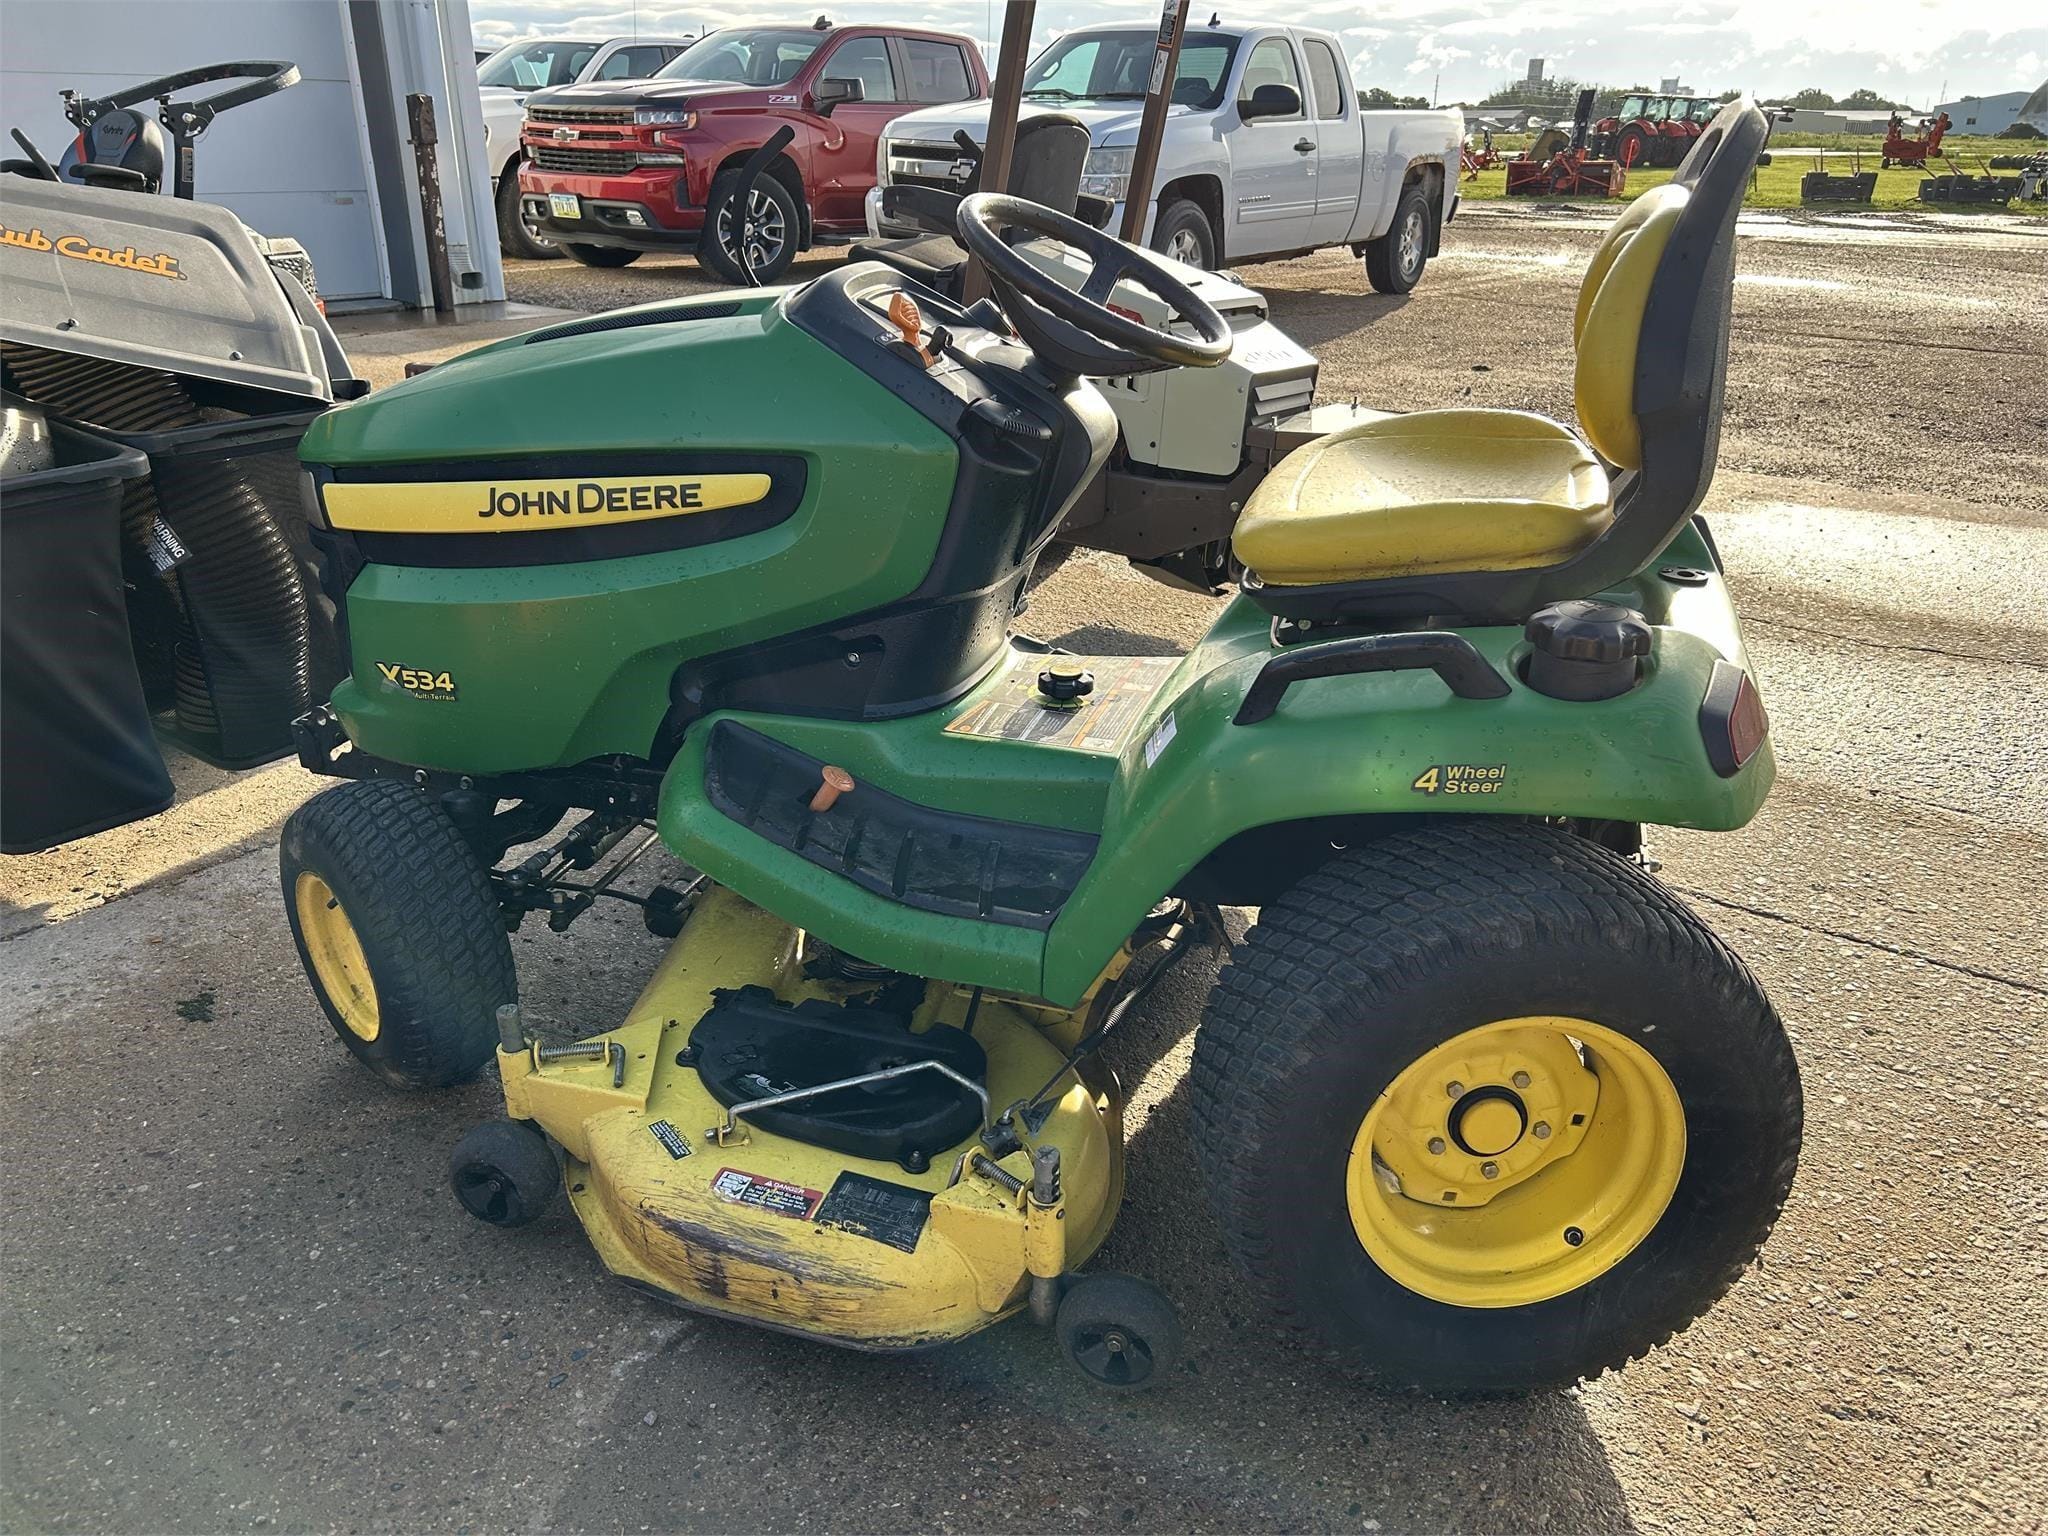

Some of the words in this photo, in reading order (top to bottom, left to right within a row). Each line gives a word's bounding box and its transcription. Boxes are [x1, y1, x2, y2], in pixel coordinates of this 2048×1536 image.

[0, 223, 52, 252] ub
[56, 235, 179, 279] Cadet
[478, 487, 571, 518] JOHN
[577, 483, 703, 513] DEERE
[1414, 767, 1439, 793] 4
[1446, 765, 1506, 780] Wheel
[1444, 779, 1503, 794] Steer
